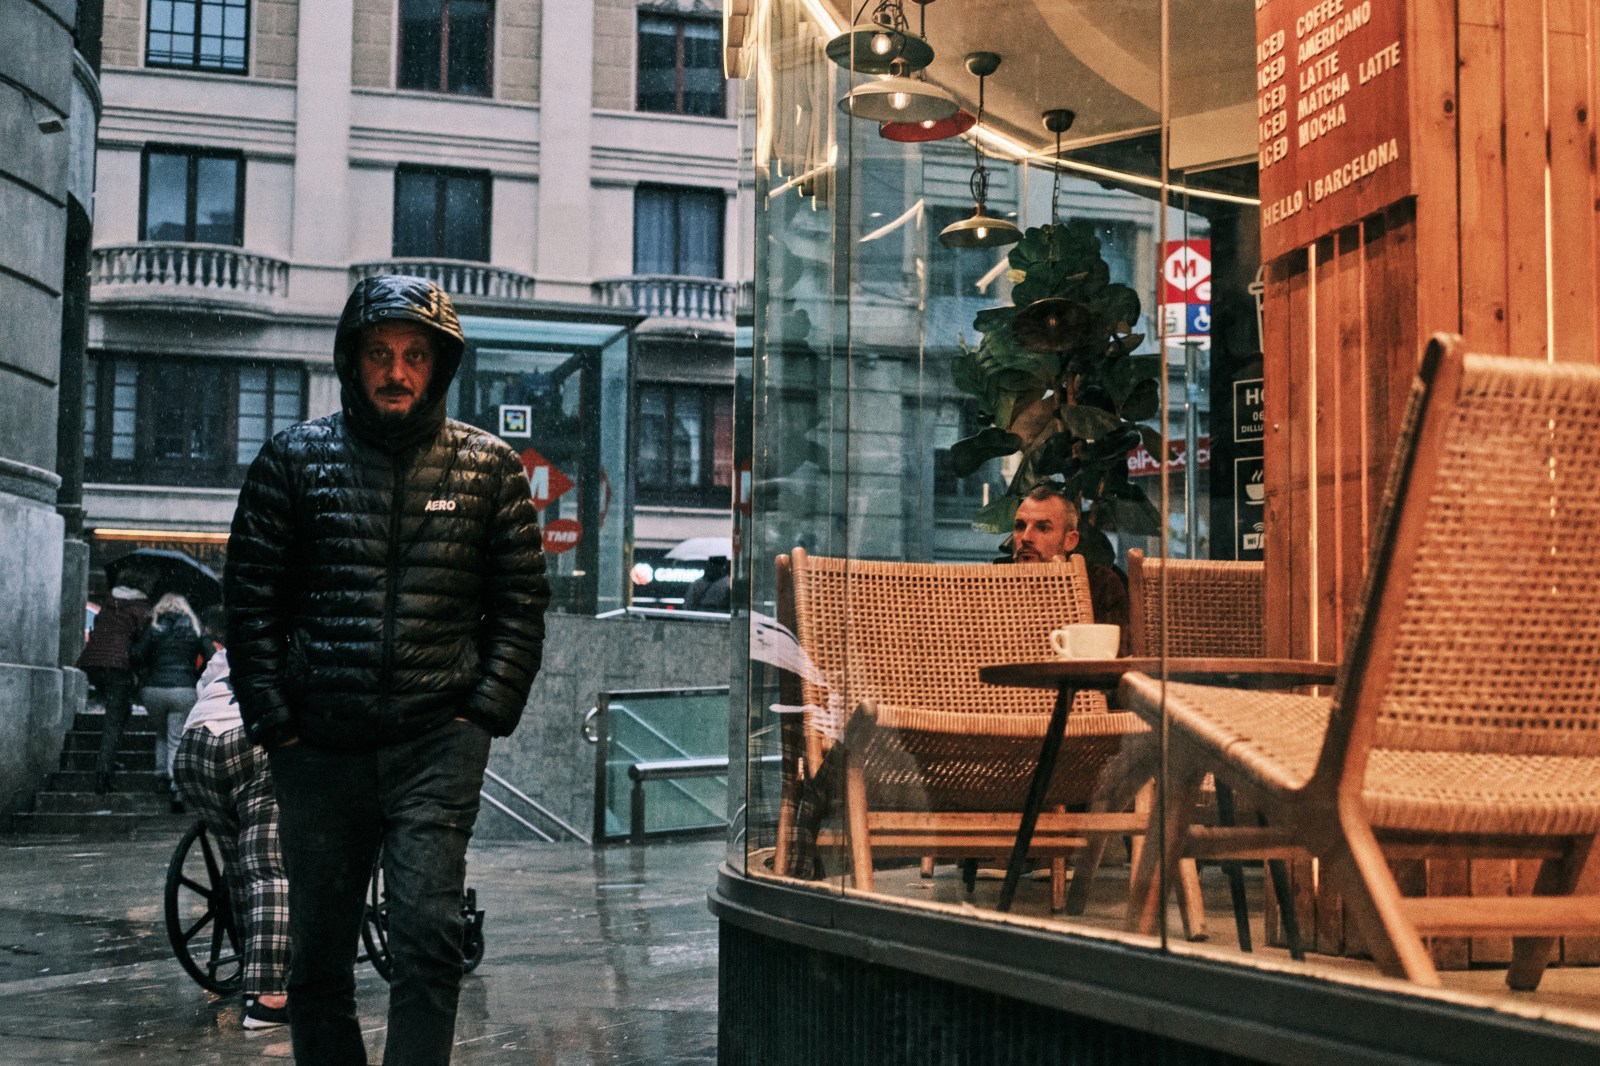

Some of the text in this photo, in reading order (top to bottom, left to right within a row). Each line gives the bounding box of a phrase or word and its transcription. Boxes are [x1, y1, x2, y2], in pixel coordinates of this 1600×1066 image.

[1257, 0, 1344, 65] ICED COFFEE
[1257, 1, 1371, 92] ICED AMERICANO
[1258, 51, 1339, 118] ICED LATTE
[1259, 41, 1400, 144] ICED MATCHA LATTE
[1259, 104, 1346, 170] ICED MOCHA
[1314, 138, 1399, 202] BARCELONA
[1173, 260, 1197, 278] M
[425, 500, 456, 511] AERO
[547, 531, 578, 542] TMB
